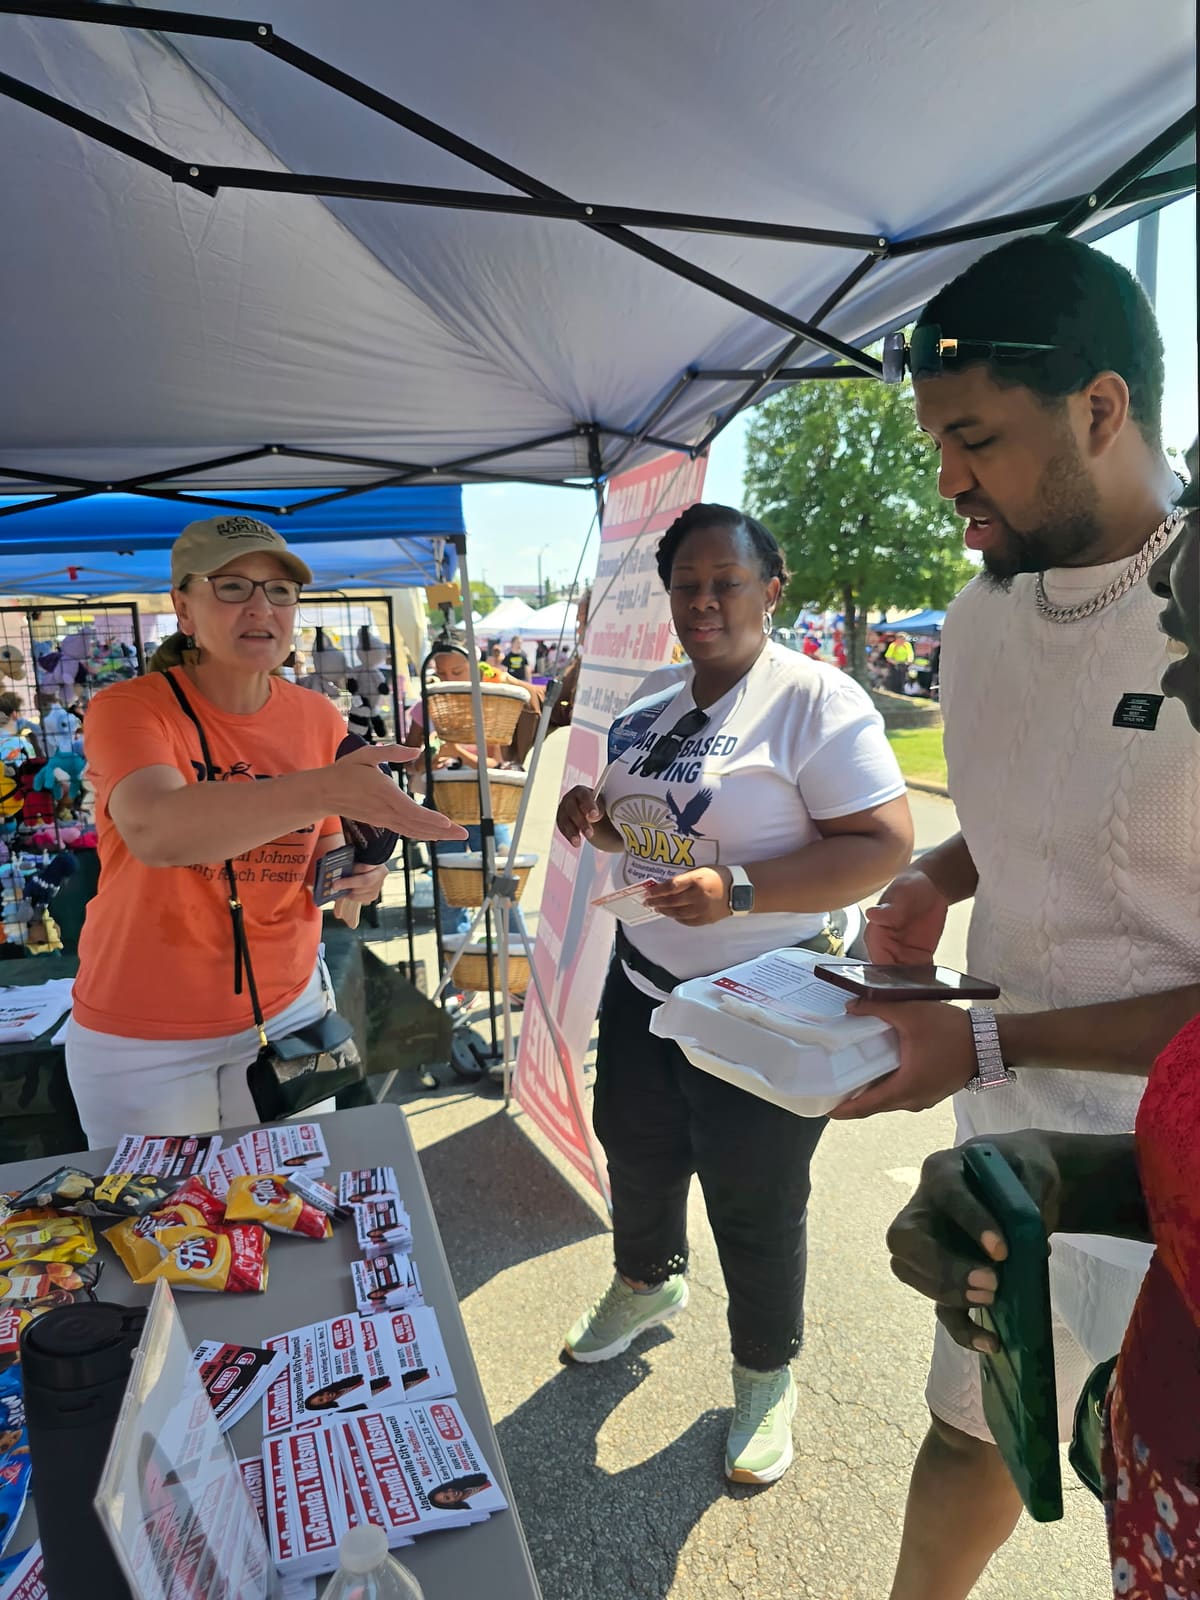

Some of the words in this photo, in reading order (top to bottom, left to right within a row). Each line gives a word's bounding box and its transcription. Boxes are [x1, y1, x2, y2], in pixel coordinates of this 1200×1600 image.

[620, 823, 696, 867] AJAX
[289, 1335, 300, 1359] Council
[292, 1358, 303, 1373] City
[268, 1381, 291, 1427] LaConda
[291, 1371, 305, 1414] Jacksonville
[385, 1414, 405, 1444] Council
[434, 1413, 449, 1431] VOTE
[363, 1415, 393, 1461] Watson
[404, 1428, 422, 1454] Position
[293, 1434, 320, 1481] Watson
[396, 1442, 410, 1460] City
[373, 1456, 397, 1471] T.
[416, 1458, 432, 1477] Ward
[437, 1464, 451, 1481] Early
[449, 1457, 462, 1471] OUR
[460, 1457, 471, 1471] OUR
[469, 1458, 481, 1472] OUR
[298, 1478, 321, 1493] T.
[378, 1466, 416, 1524] LaConda
[402, 1458, 431, 1512] Jacksonville
[299, 1489, 332, 1549] LaConda
